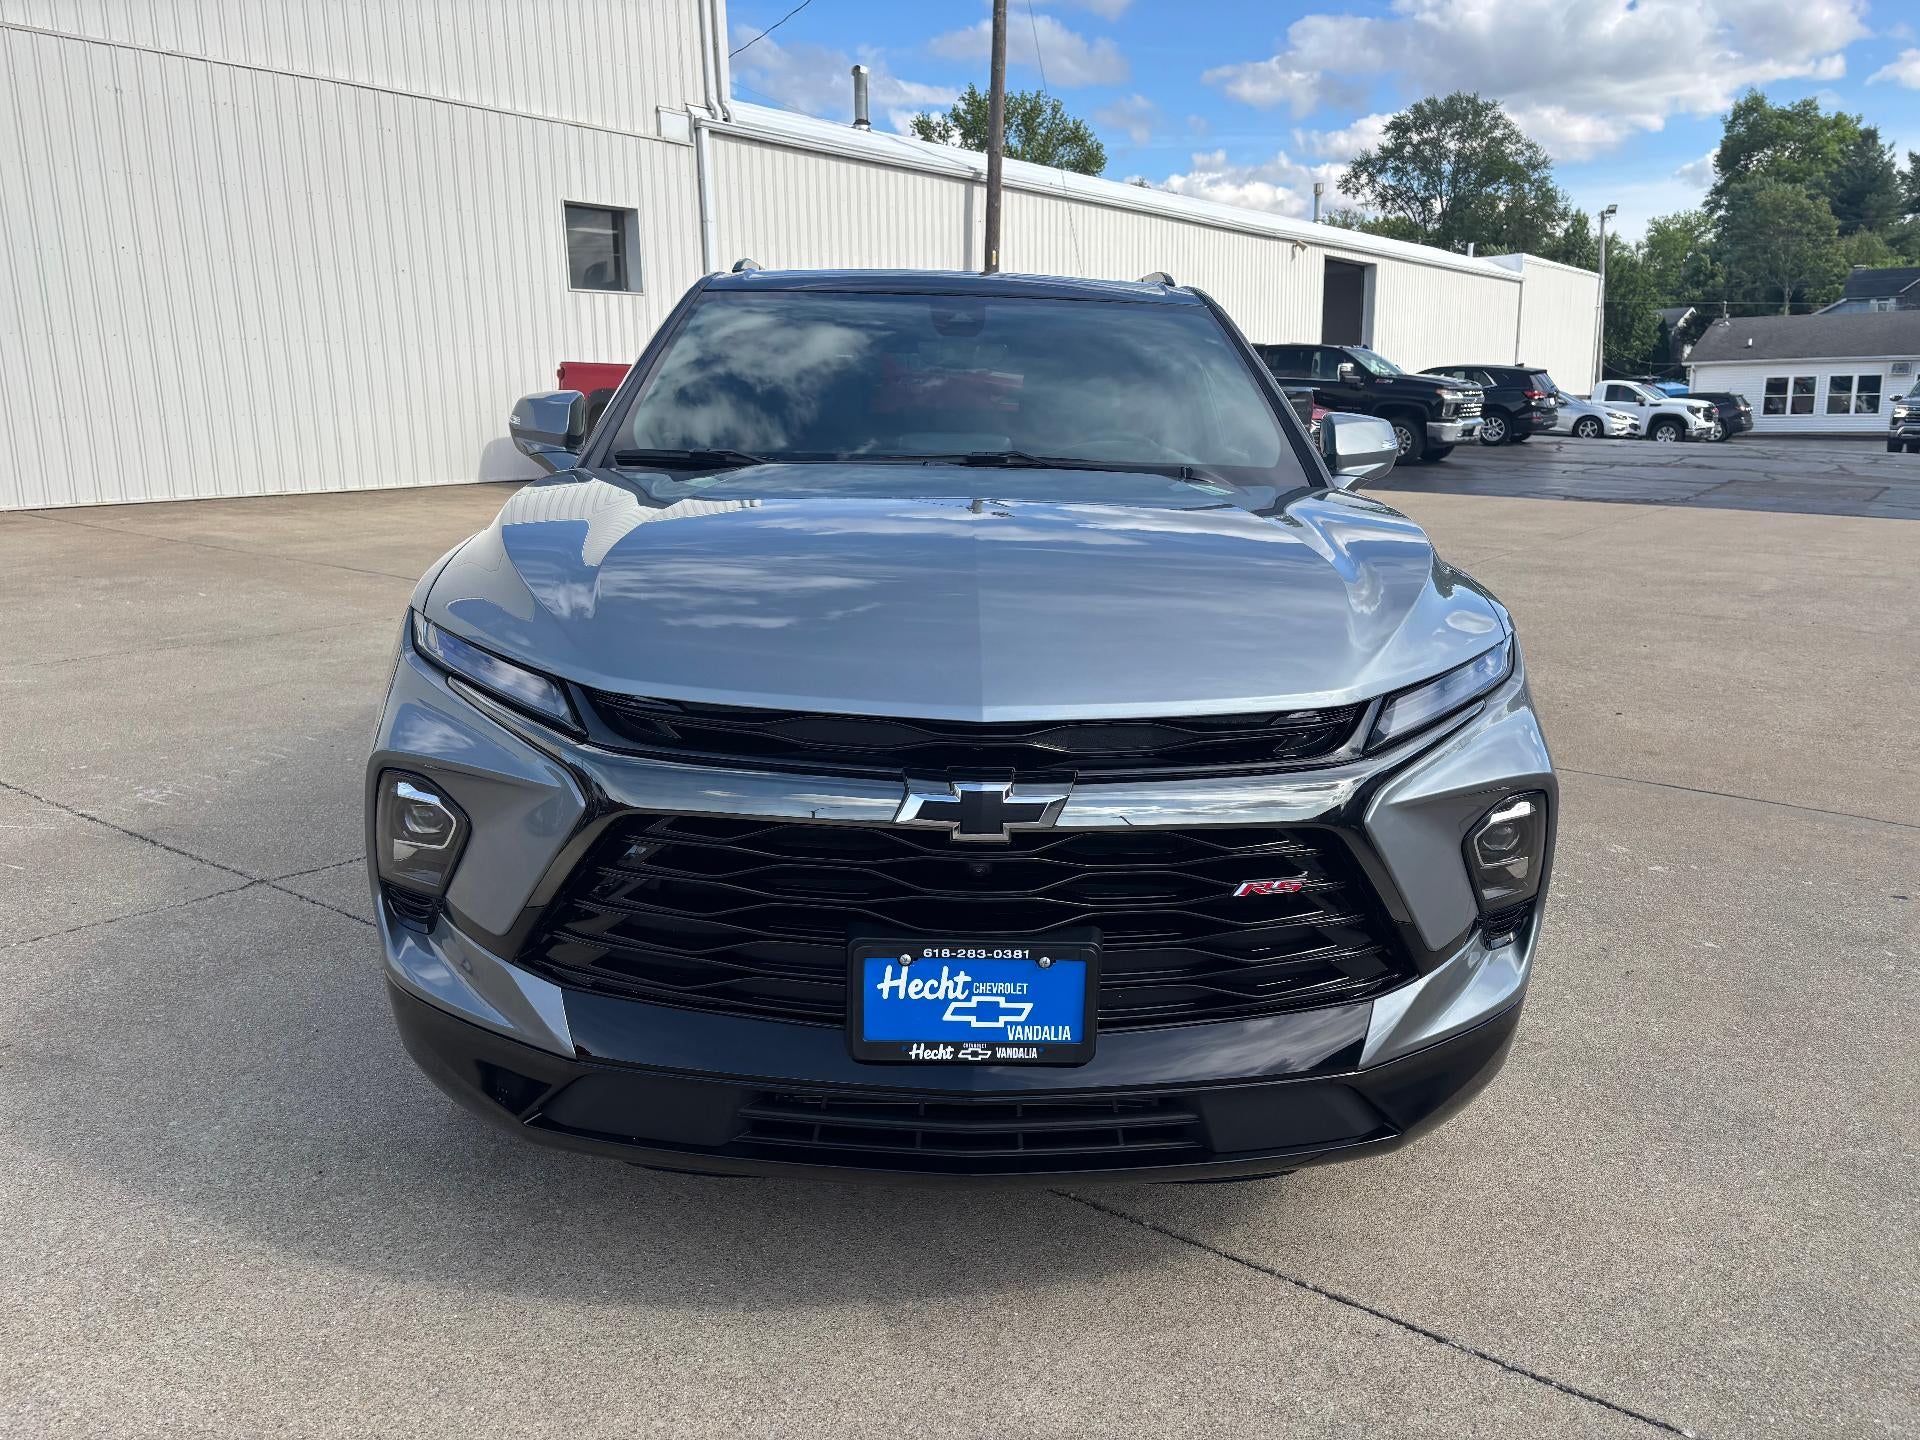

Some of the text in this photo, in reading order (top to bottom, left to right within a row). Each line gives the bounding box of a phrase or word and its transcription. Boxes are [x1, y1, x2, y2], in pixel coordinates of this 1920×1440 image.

[1233, 880, 1303, 897] RS
[923, 948, 1030, 960] 618-283-0381
[877, 964, 1029, 1000] Hecht CHEVROLET
[1007, 1025, 1071, 1041] VANDALIA
[909, 1043, 1038, 1060] Hecht VANDALIA
